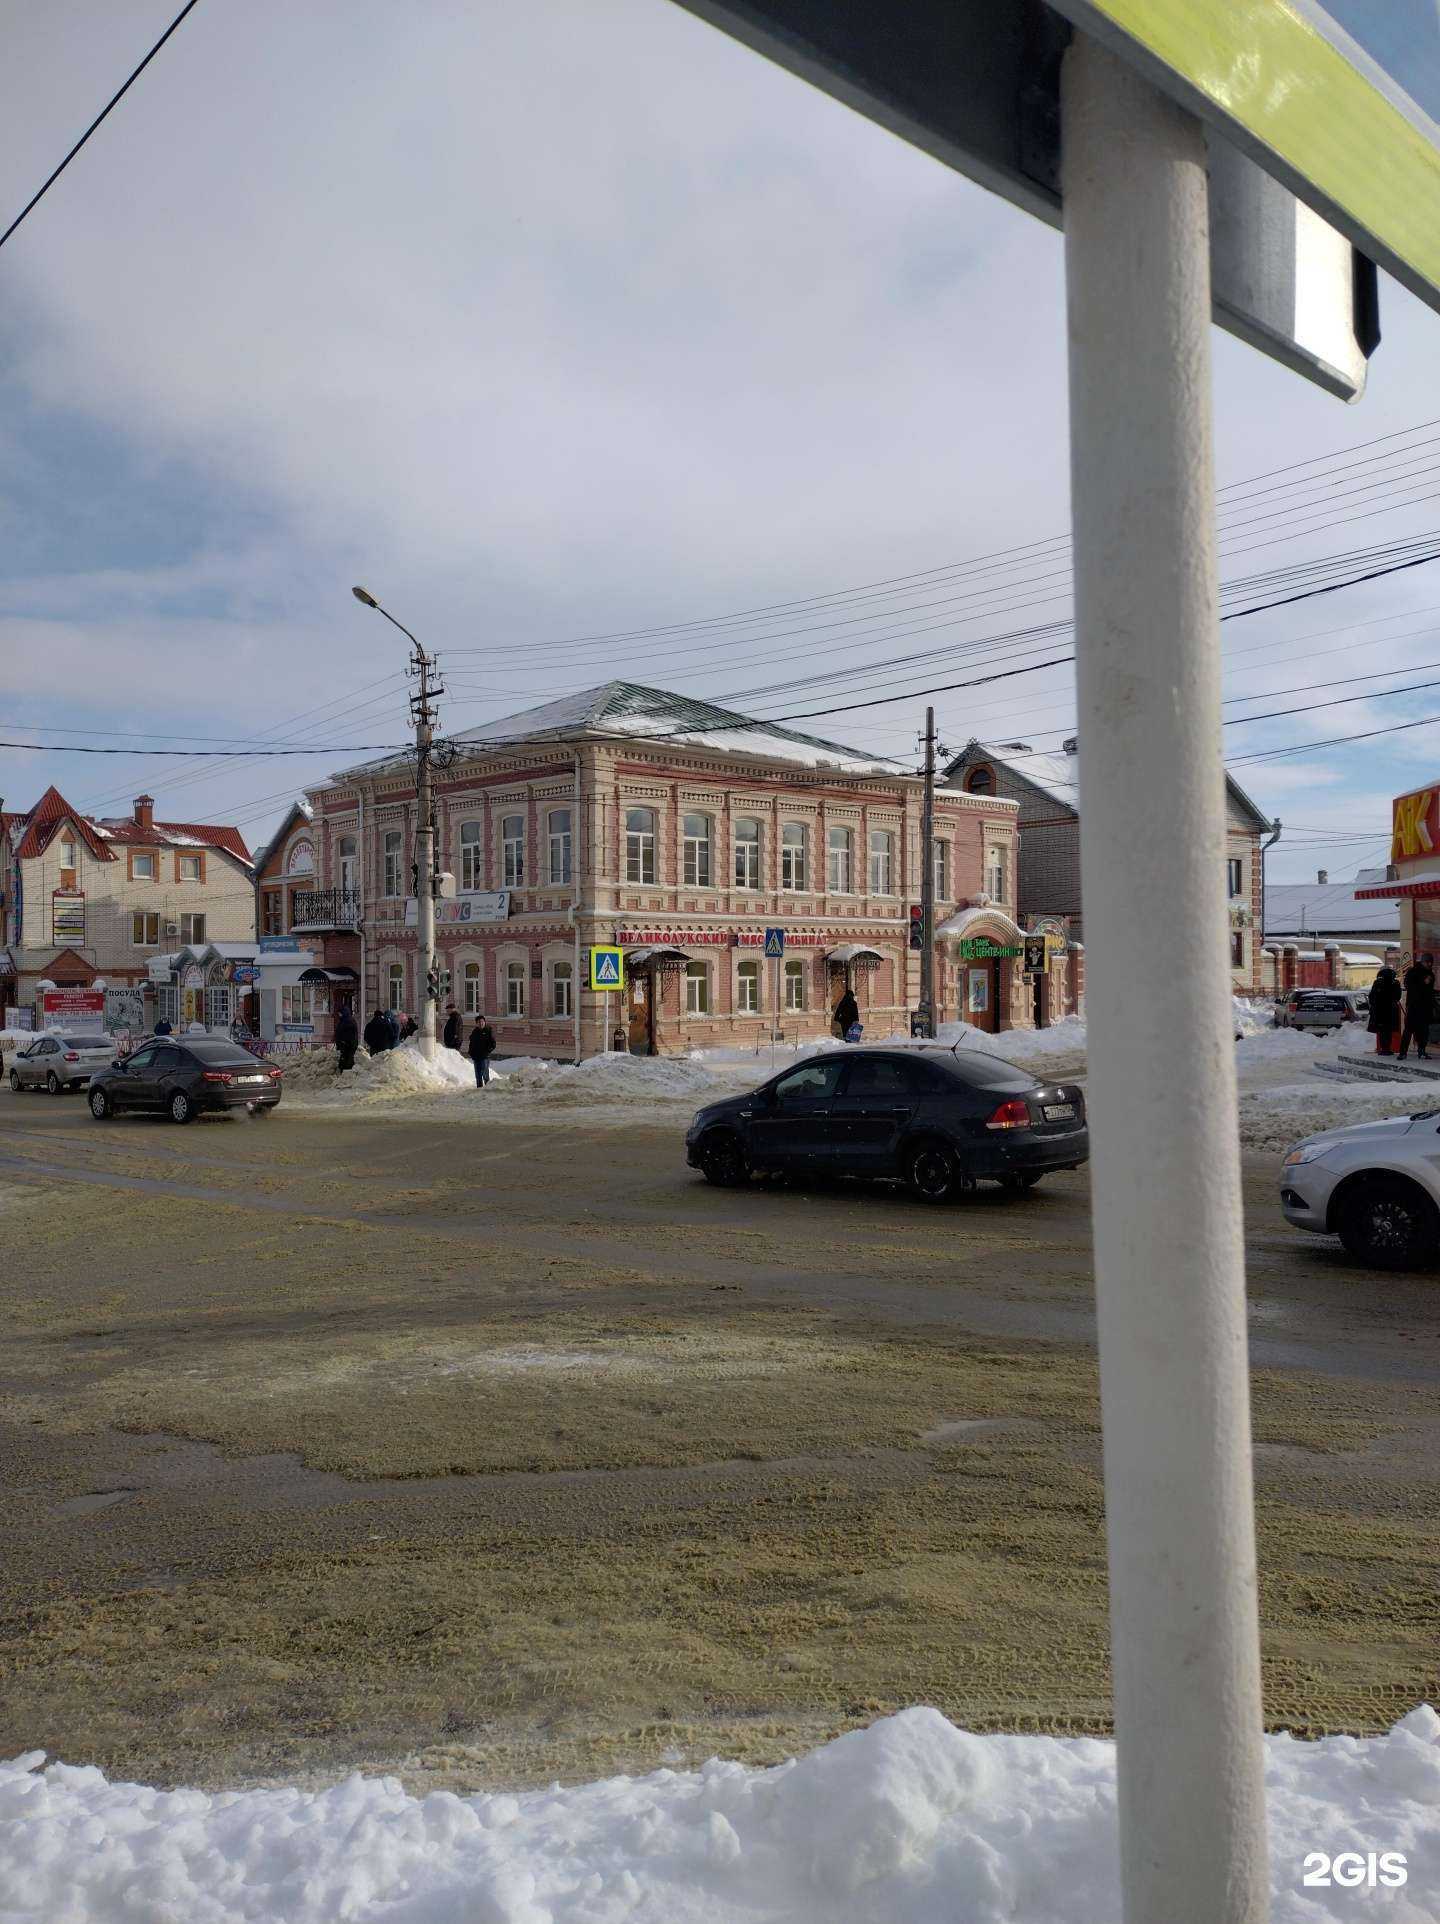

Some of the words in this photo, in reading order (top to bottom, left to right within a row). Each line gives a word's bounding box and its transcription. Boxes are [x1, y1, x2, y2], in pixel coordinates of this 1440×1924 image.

[497, 894, 505, 909] 2
[619, 931, 728, 944] ВЕЛИКОЛУКСКИЙ
[741, 934, 827, 946] МЯСМБИНАТ
